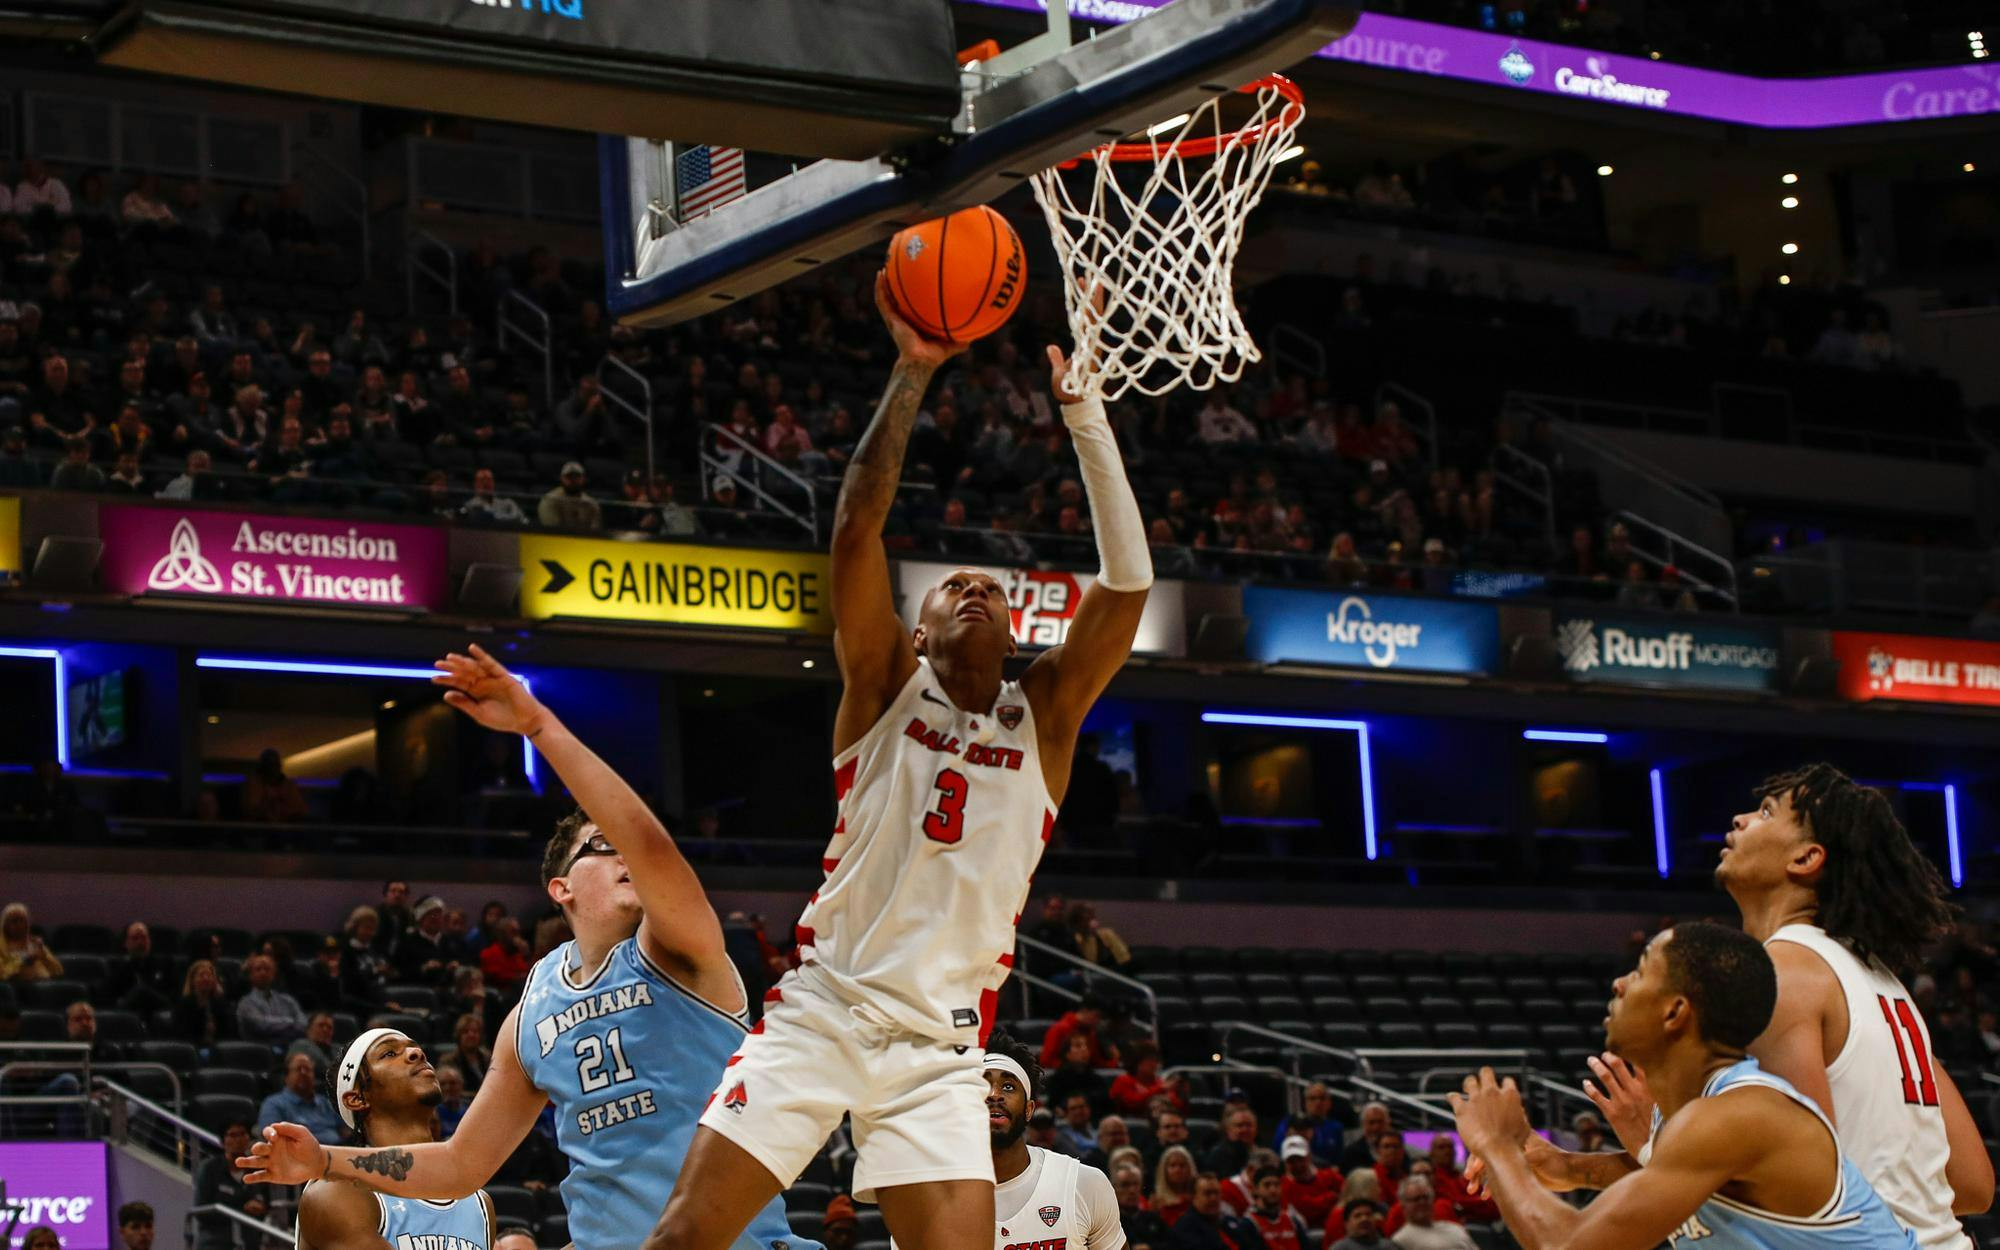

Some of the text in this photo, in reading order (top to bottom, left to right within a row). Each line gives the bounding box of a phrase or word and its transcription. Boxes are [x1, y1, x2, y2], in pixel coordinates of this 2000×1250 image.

[1555, 67, 1670, 108] CareSource
[1882, 78, 2000, 119] Care
[230, 521, 398, 561] Ascension
[230, 561, 405, 603] St. Vincent
[589, 558, 818, 615] GAINBRIDGE
[1005, 573, 1067, 612] the
[1327, 596, 1420, 668] Kroger
[1603, 628, 1693, 669] Ruoff
[1894, 657, 2000, 690] BELLE TIR
[903, 717, 961, 755] BALL
[922, 767, 969, 845] 3
[574, 1026, 636, 1095] 21
[1877, 992, 1940, 1106] 11
[577, 1088, 657, 1135] STATE
